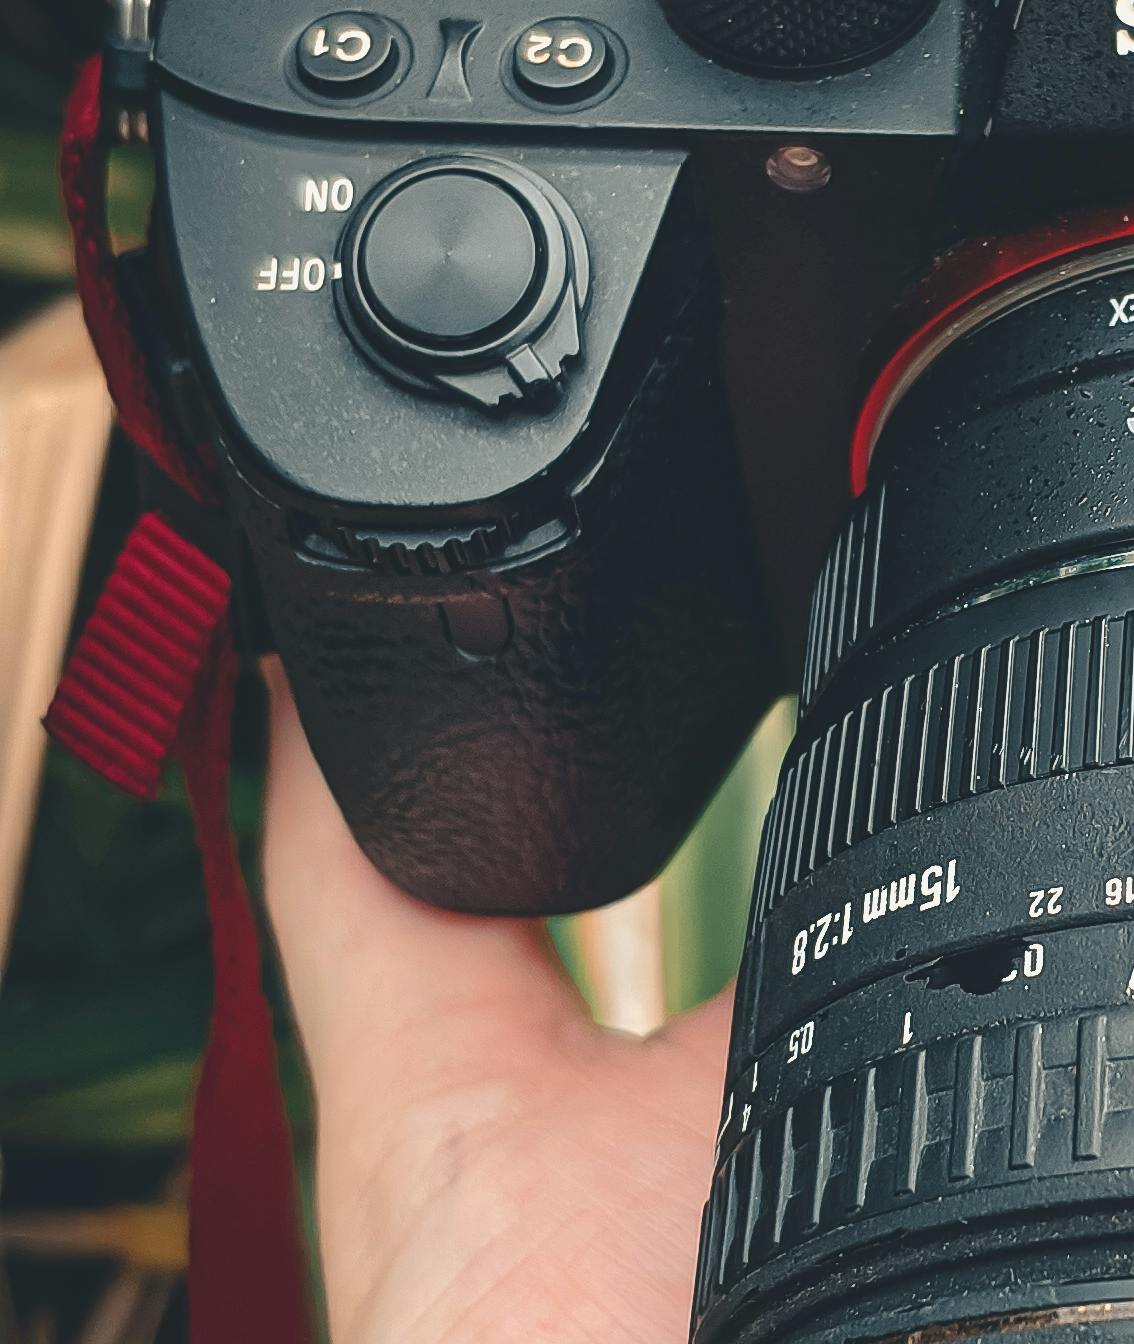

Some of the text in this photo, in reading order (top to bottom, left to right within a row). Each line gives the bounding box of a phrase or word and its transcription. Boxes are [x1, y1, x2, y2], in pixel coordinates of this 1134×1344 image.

[310, 27, 372, 63] C1
[523, 32, 593, 69] C2
[303, 177, 354, 212] ON
[255, 256, 325, 292] OFF
[791, 858, 961, 976] 15mm 1:2.8
[1028, 885, 1065, 919] 22
[787, 1020, 815, 1064] 0.5
[902, 1011, 914, 1045] 1
